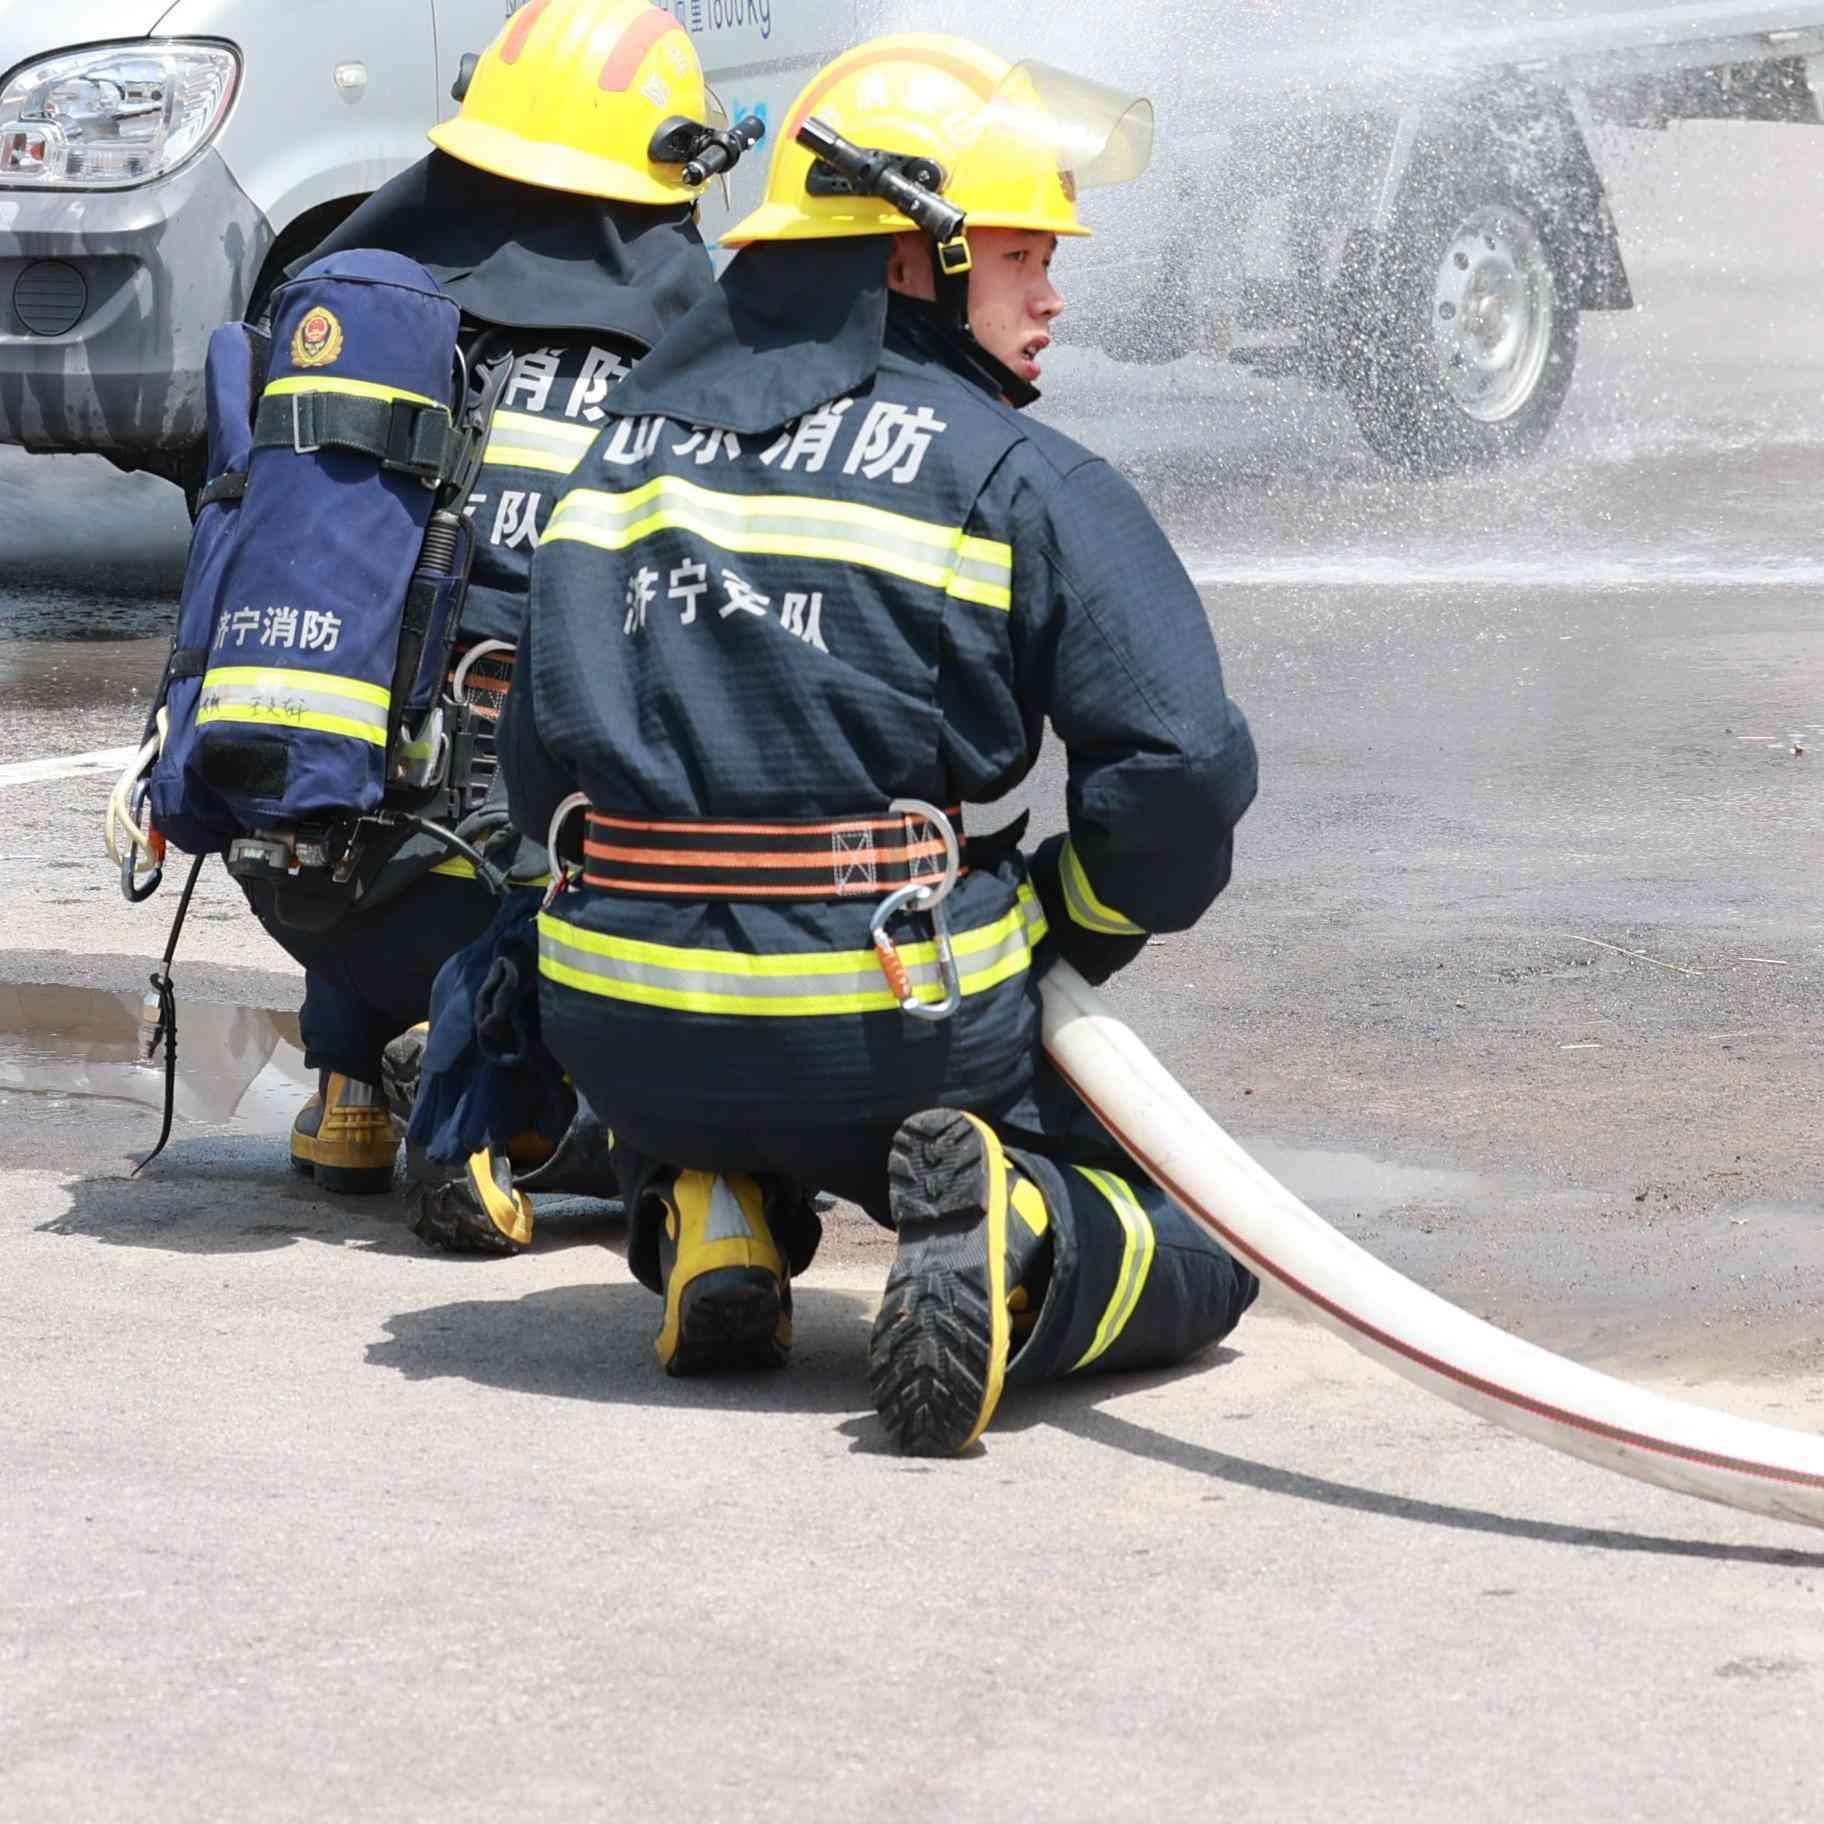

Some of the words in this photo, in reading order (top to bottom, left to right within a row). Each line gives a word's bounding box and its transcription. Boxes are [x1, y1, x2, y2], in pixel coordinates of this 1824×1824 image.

[212, 605, 343, 652] 济宁消防
[623, 557, 830, 654] 济宁支队
